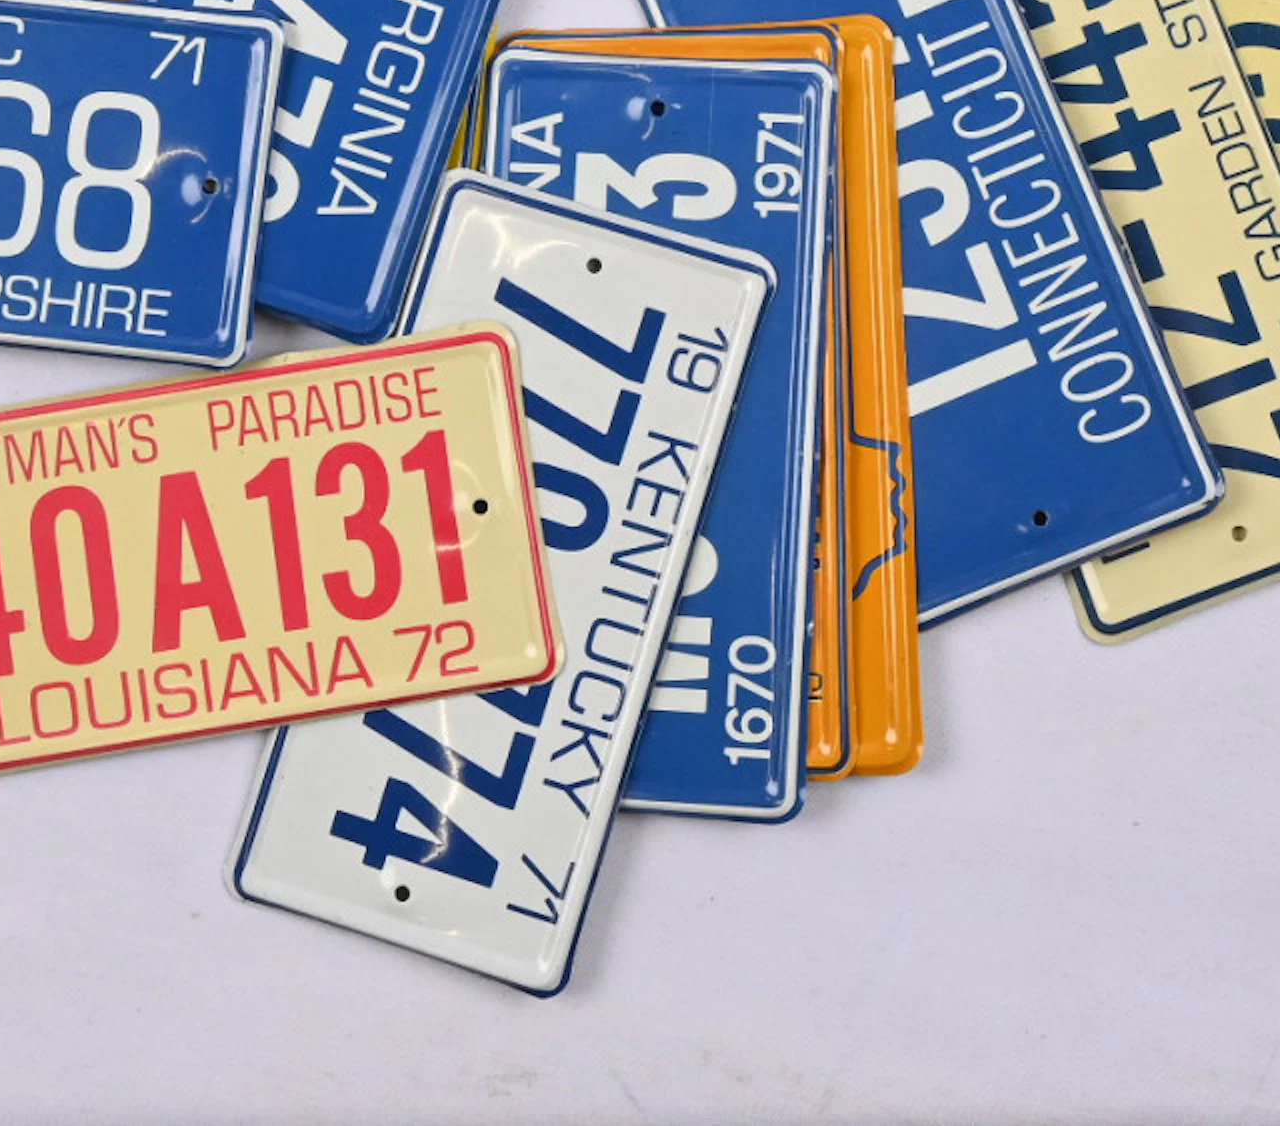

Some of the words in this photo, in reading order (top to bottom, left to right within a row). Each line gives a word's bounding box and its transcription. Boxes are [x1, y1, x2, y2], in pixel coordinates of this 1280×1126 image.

[148, 31, 206, 85] 71
[754, 111, 804, 217] 1971
[919, 19, 1152, 444] CONNECTICUT
[667, 326, 729, 393] 19
[206, 366, 443, 451] PARADISE
[393, 619, 478, 683] 72
[543, 429, 699, 819] KENTUCKY
[725, 634, 776, 766] 1670
[507, 851, 580, 926] 71
